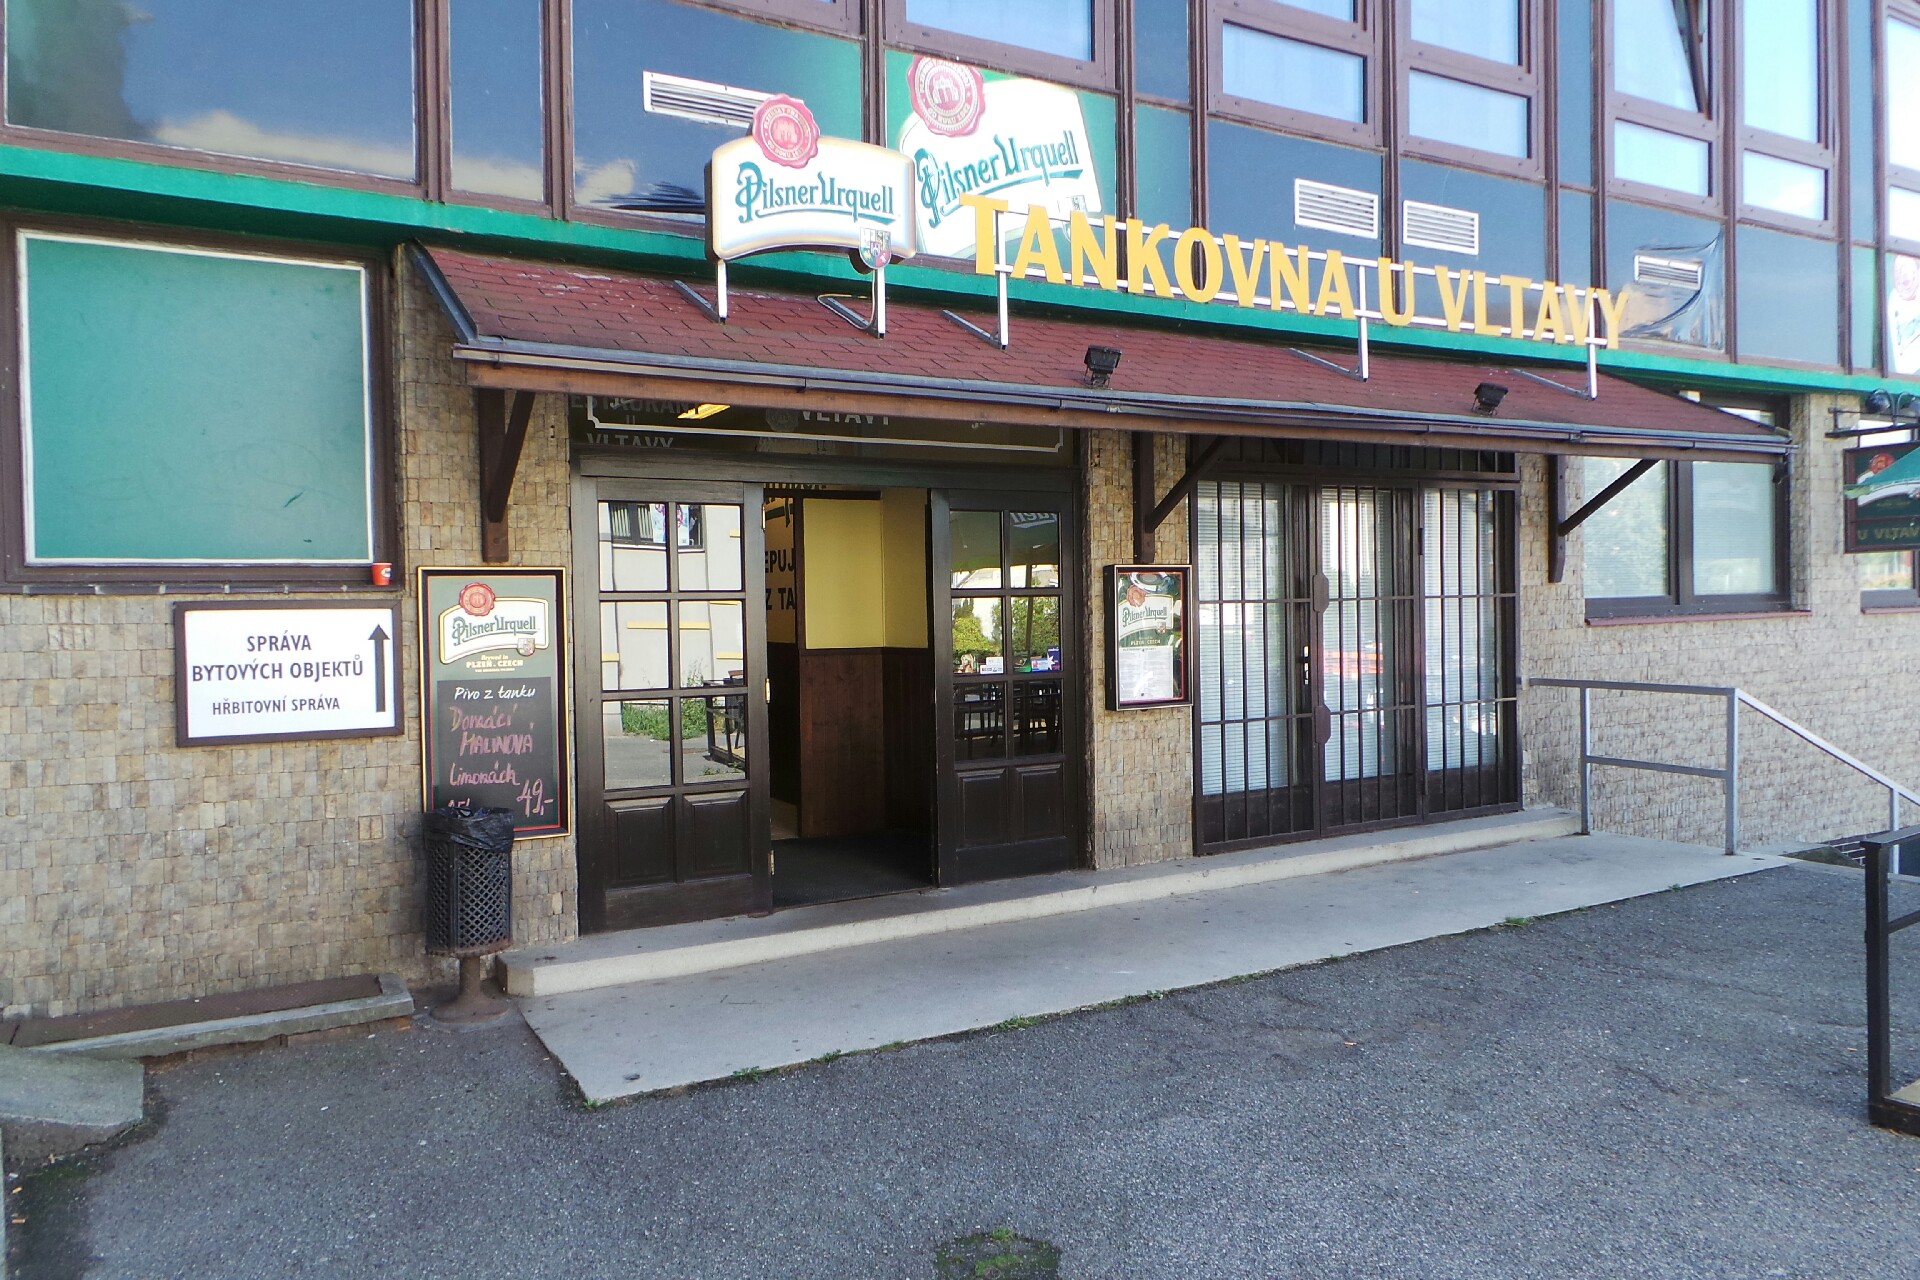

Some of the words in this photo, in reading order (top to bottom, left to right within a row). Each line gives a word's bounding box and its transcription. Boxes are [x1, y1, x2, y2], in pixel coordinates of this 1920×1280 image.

[914, 147, 1000, 229] Pilsner
[993, 129, 1080, 187] Urquell
[735, 161, 819, 224] Pilsner
[817, 170, 894, 223] Urquell
[960, 192, 1357, 320] TANKOVNA
[1377, 256, 1415, 327] U
[1434, 264, 1629, 350] VLTAVY
[1122, 606, 1146, 628] Pilsner
[1144, 605, 1168, 620] Urquell
[247, 629, 312, 652] SPRÁVA
[452, 615, 495, 647] Pilsner
[493, 614, 537, 636] Urquell
[192, 658, 283, 682] BYTOVÝCH
[289, 653, 364, 683] OBJEKTŮ
[497, 659, 524, 667] CZECH
[212, 694, 287, 716] HŘBITOVNÍ
[291, 693, 341, 712] SPRÁVA
[454, 686, 480, 700] Pivo
[483, 689, 494, 699] z
[498, 684, 536, 699] tanku
